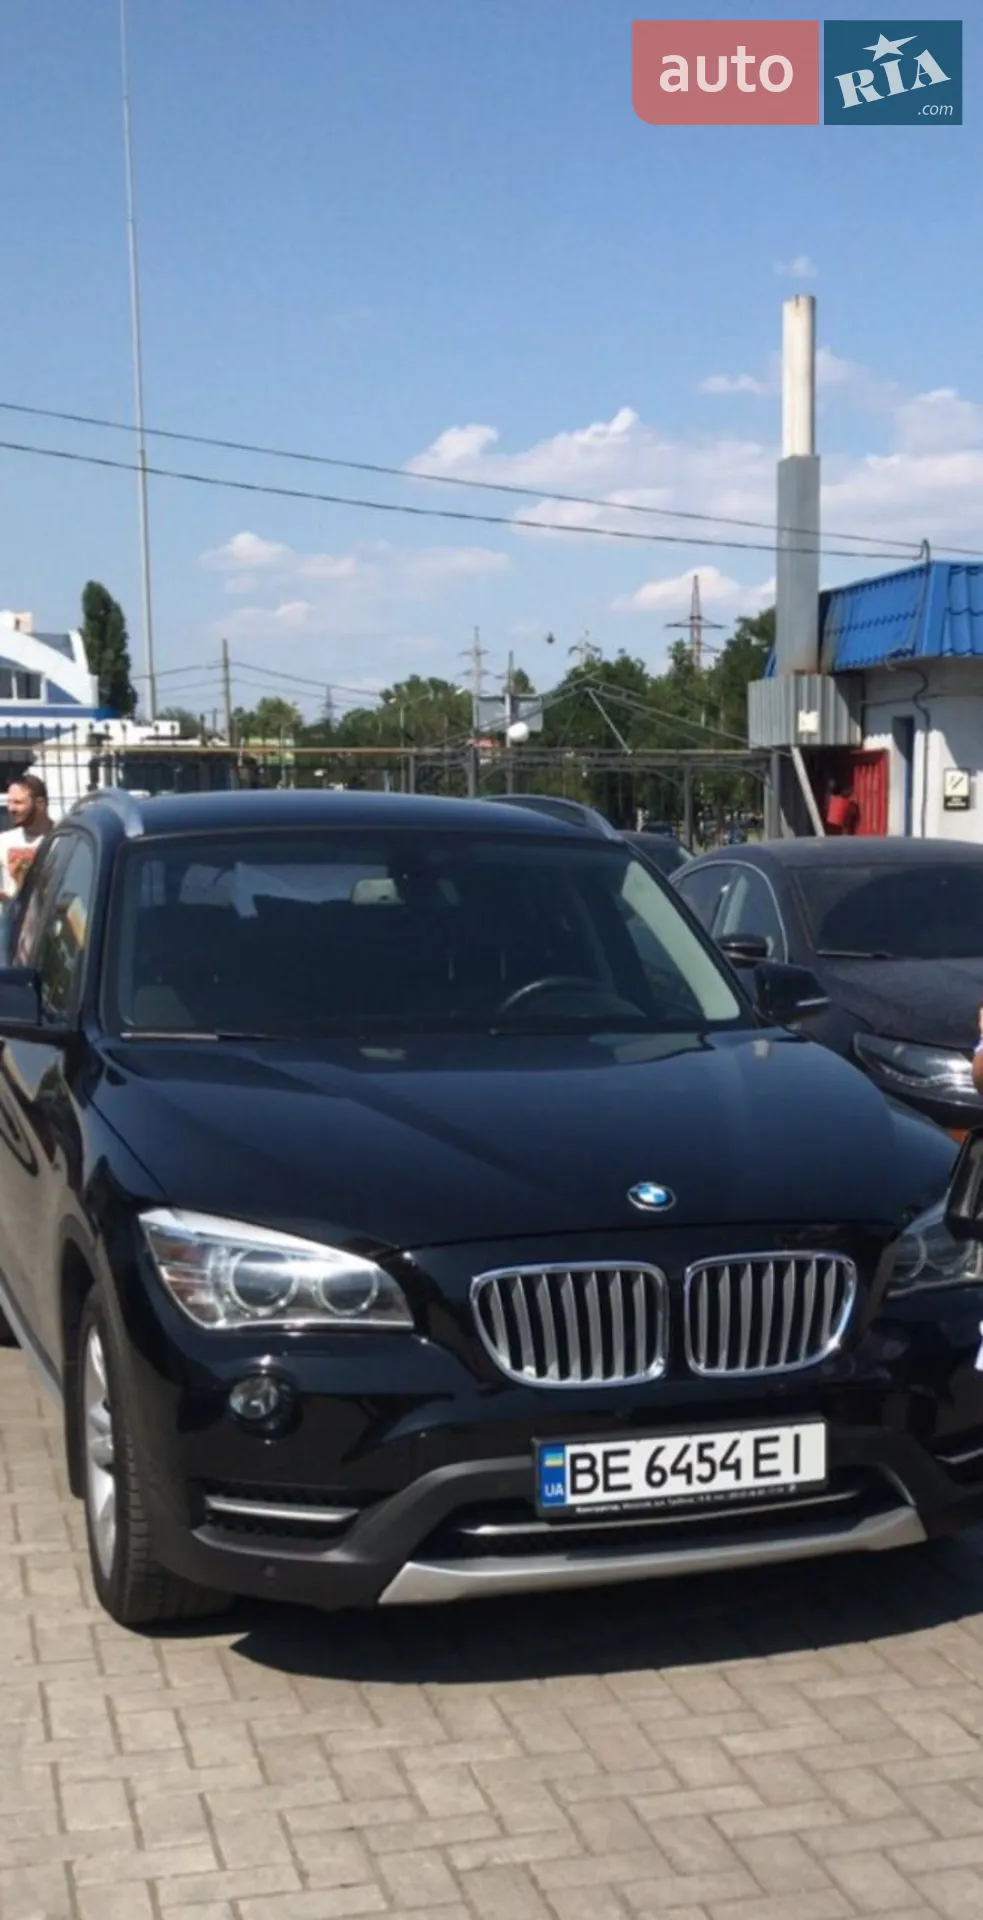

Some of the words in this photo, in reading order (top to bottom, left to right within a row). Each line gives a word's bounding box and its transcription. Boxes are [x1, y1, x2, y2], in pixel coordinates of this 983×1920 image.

[569, 1449, 632, 1496] BE
[645, 1438, 741, 1489] 6454
[545, 1484, 564, 1497] UA
